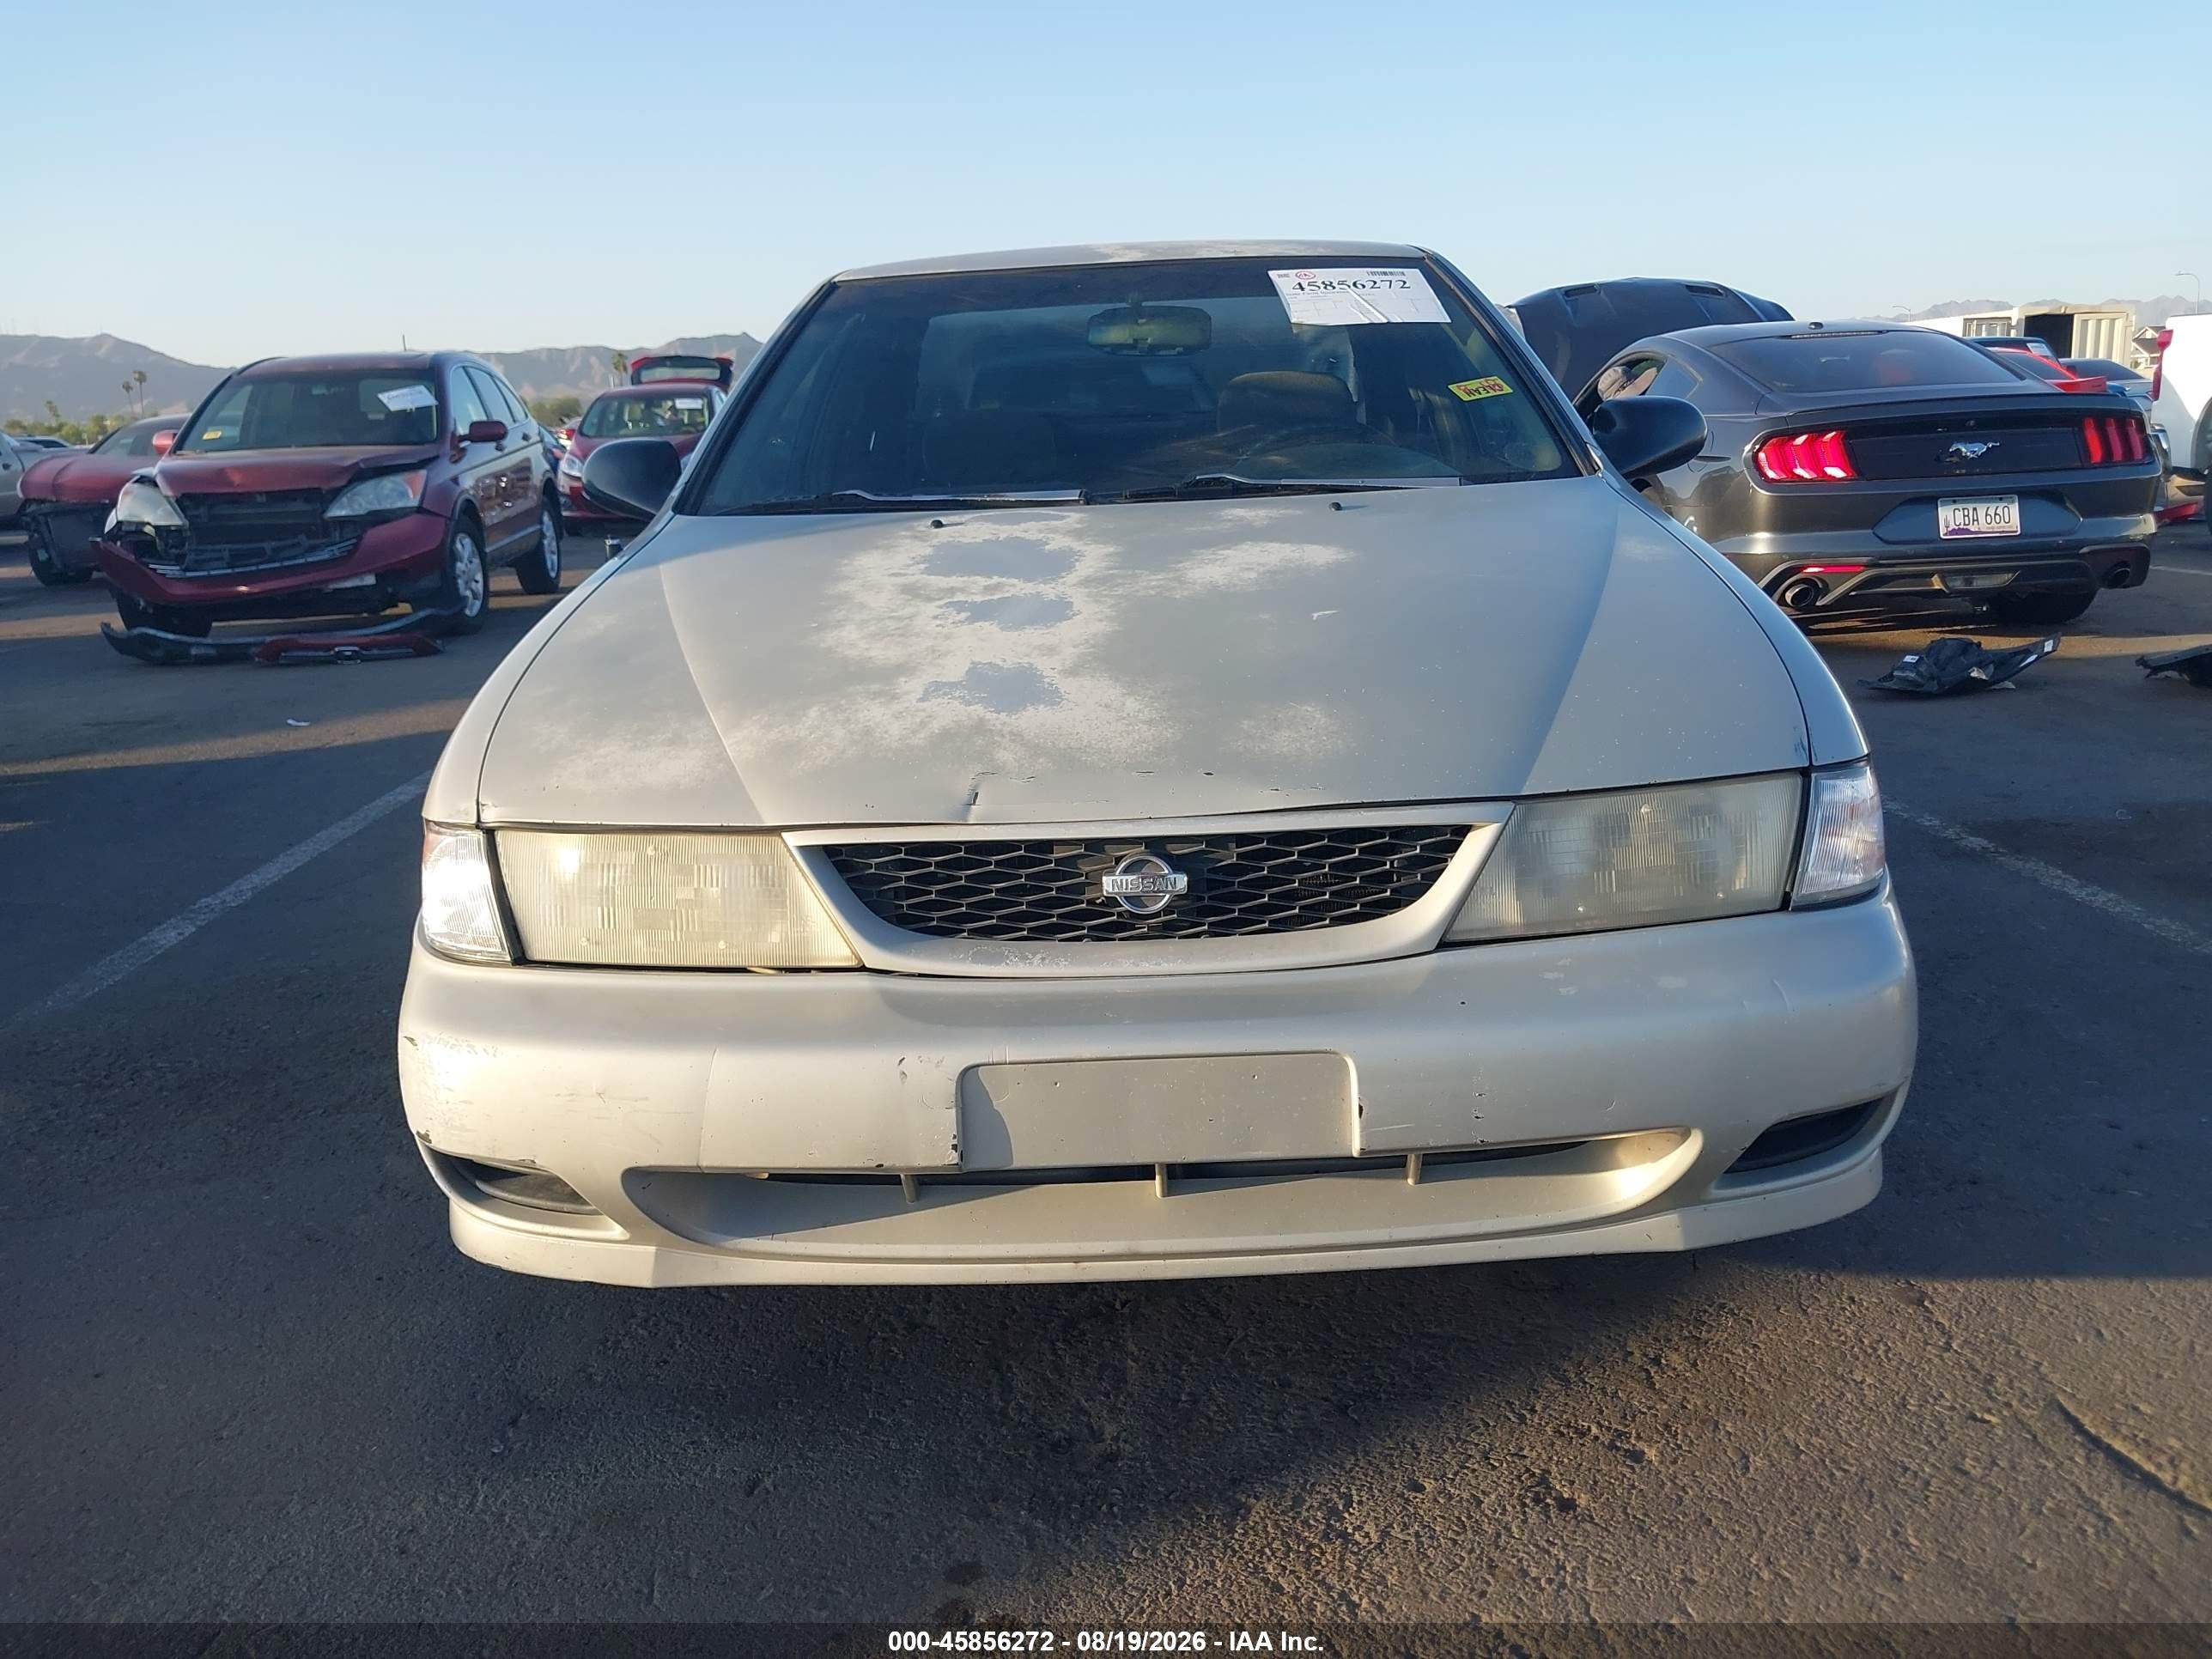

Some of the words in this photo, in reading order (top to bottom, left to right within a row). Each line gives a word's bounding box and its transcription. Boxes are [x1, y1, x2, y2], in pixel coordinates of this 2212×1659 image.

[1292, 279, 1411, 292] 45856272
[1953, 507, 1979, 526] CBA
[1984, 505, 2010, 525] 660
[1111, 877, 1177, 891] NISSAN
